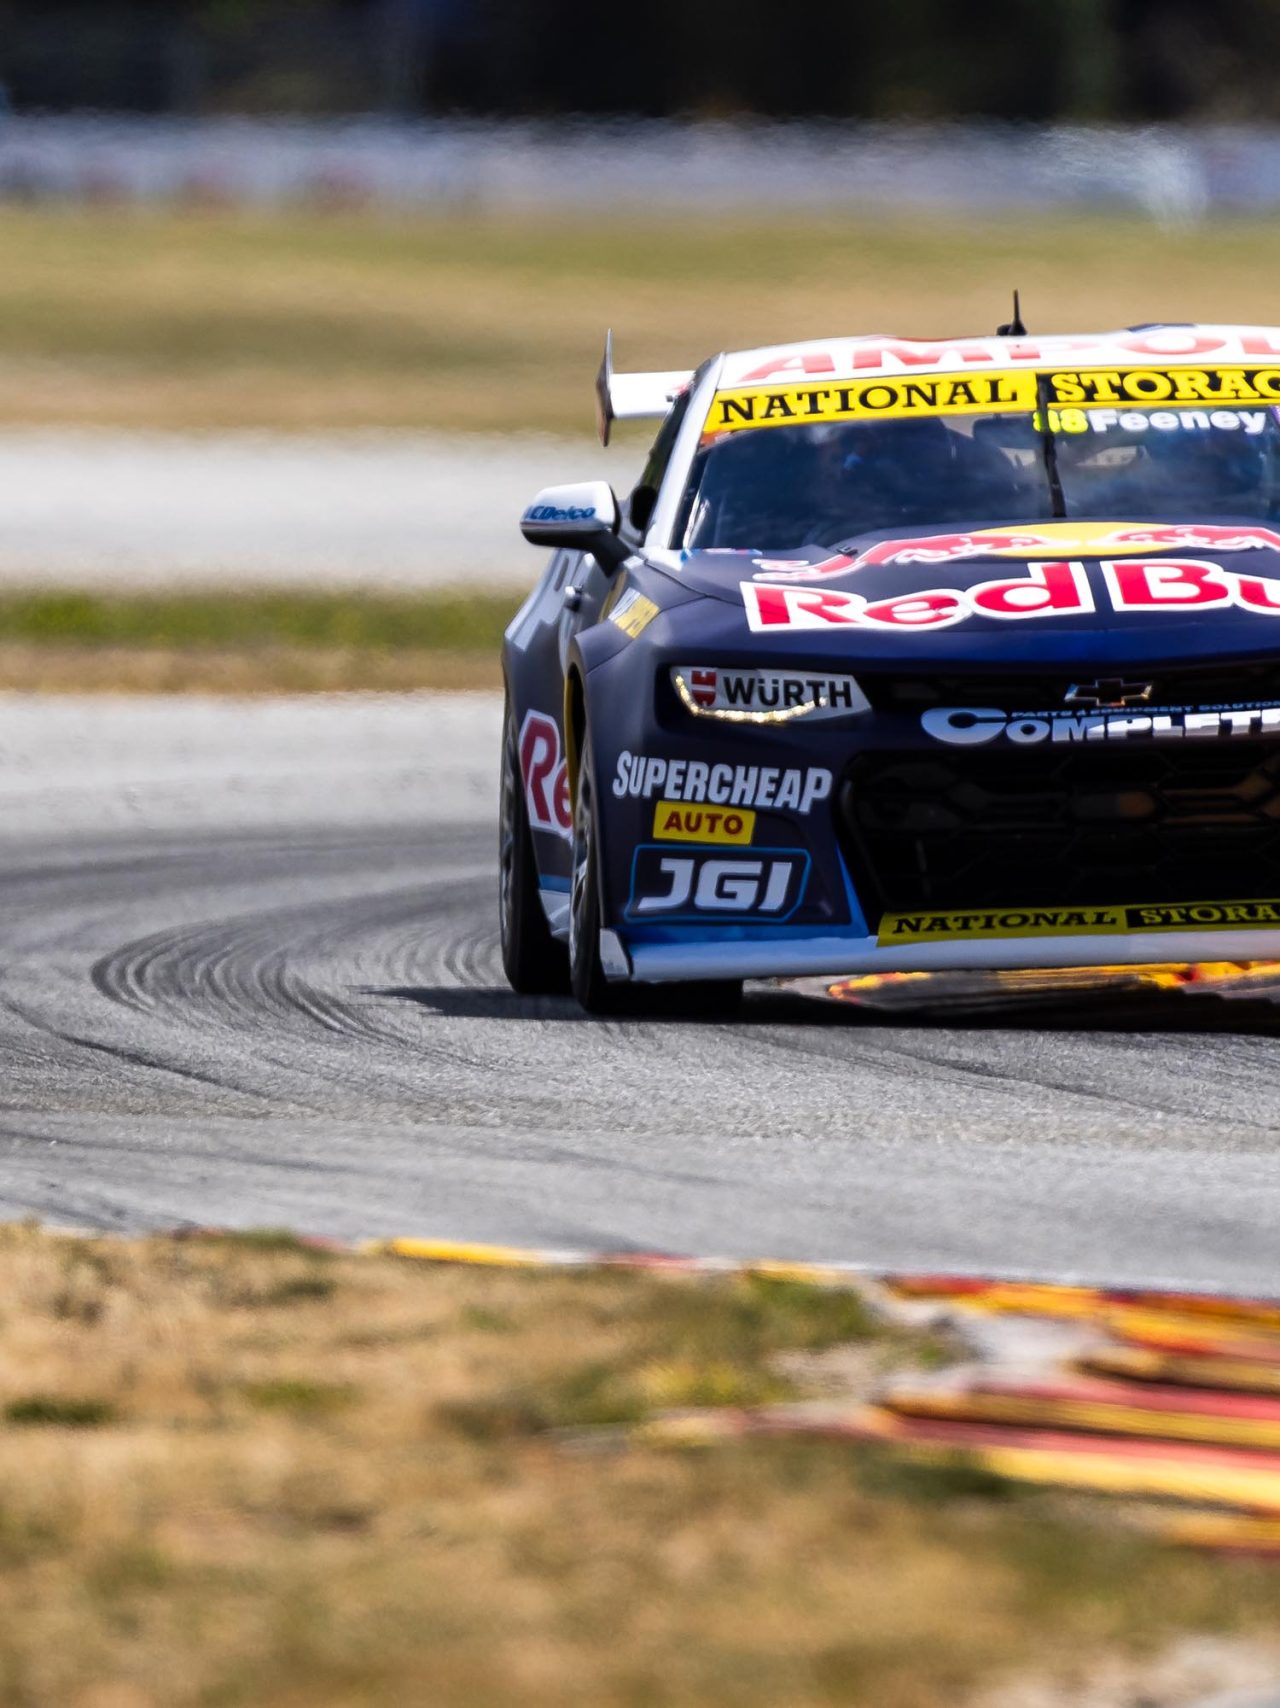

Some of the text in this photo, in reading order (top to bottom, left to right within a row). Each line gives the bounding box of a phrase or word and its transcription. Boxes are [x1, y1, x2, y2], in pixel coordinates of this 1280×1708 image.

[719, 378, 1018, 424] NATIONAL
[1087, 409, 1266, 434] Feeney
[740, 561, 1095, 632] Red
[519, 708, 573, 840] Re
[612, 750, 832, 815] SUPERCHEAP
[664, 811, 743, 836] AUTO
[638, 857, 792, 912] JGI
[892, 911, 1117, 935] NATIONAL
